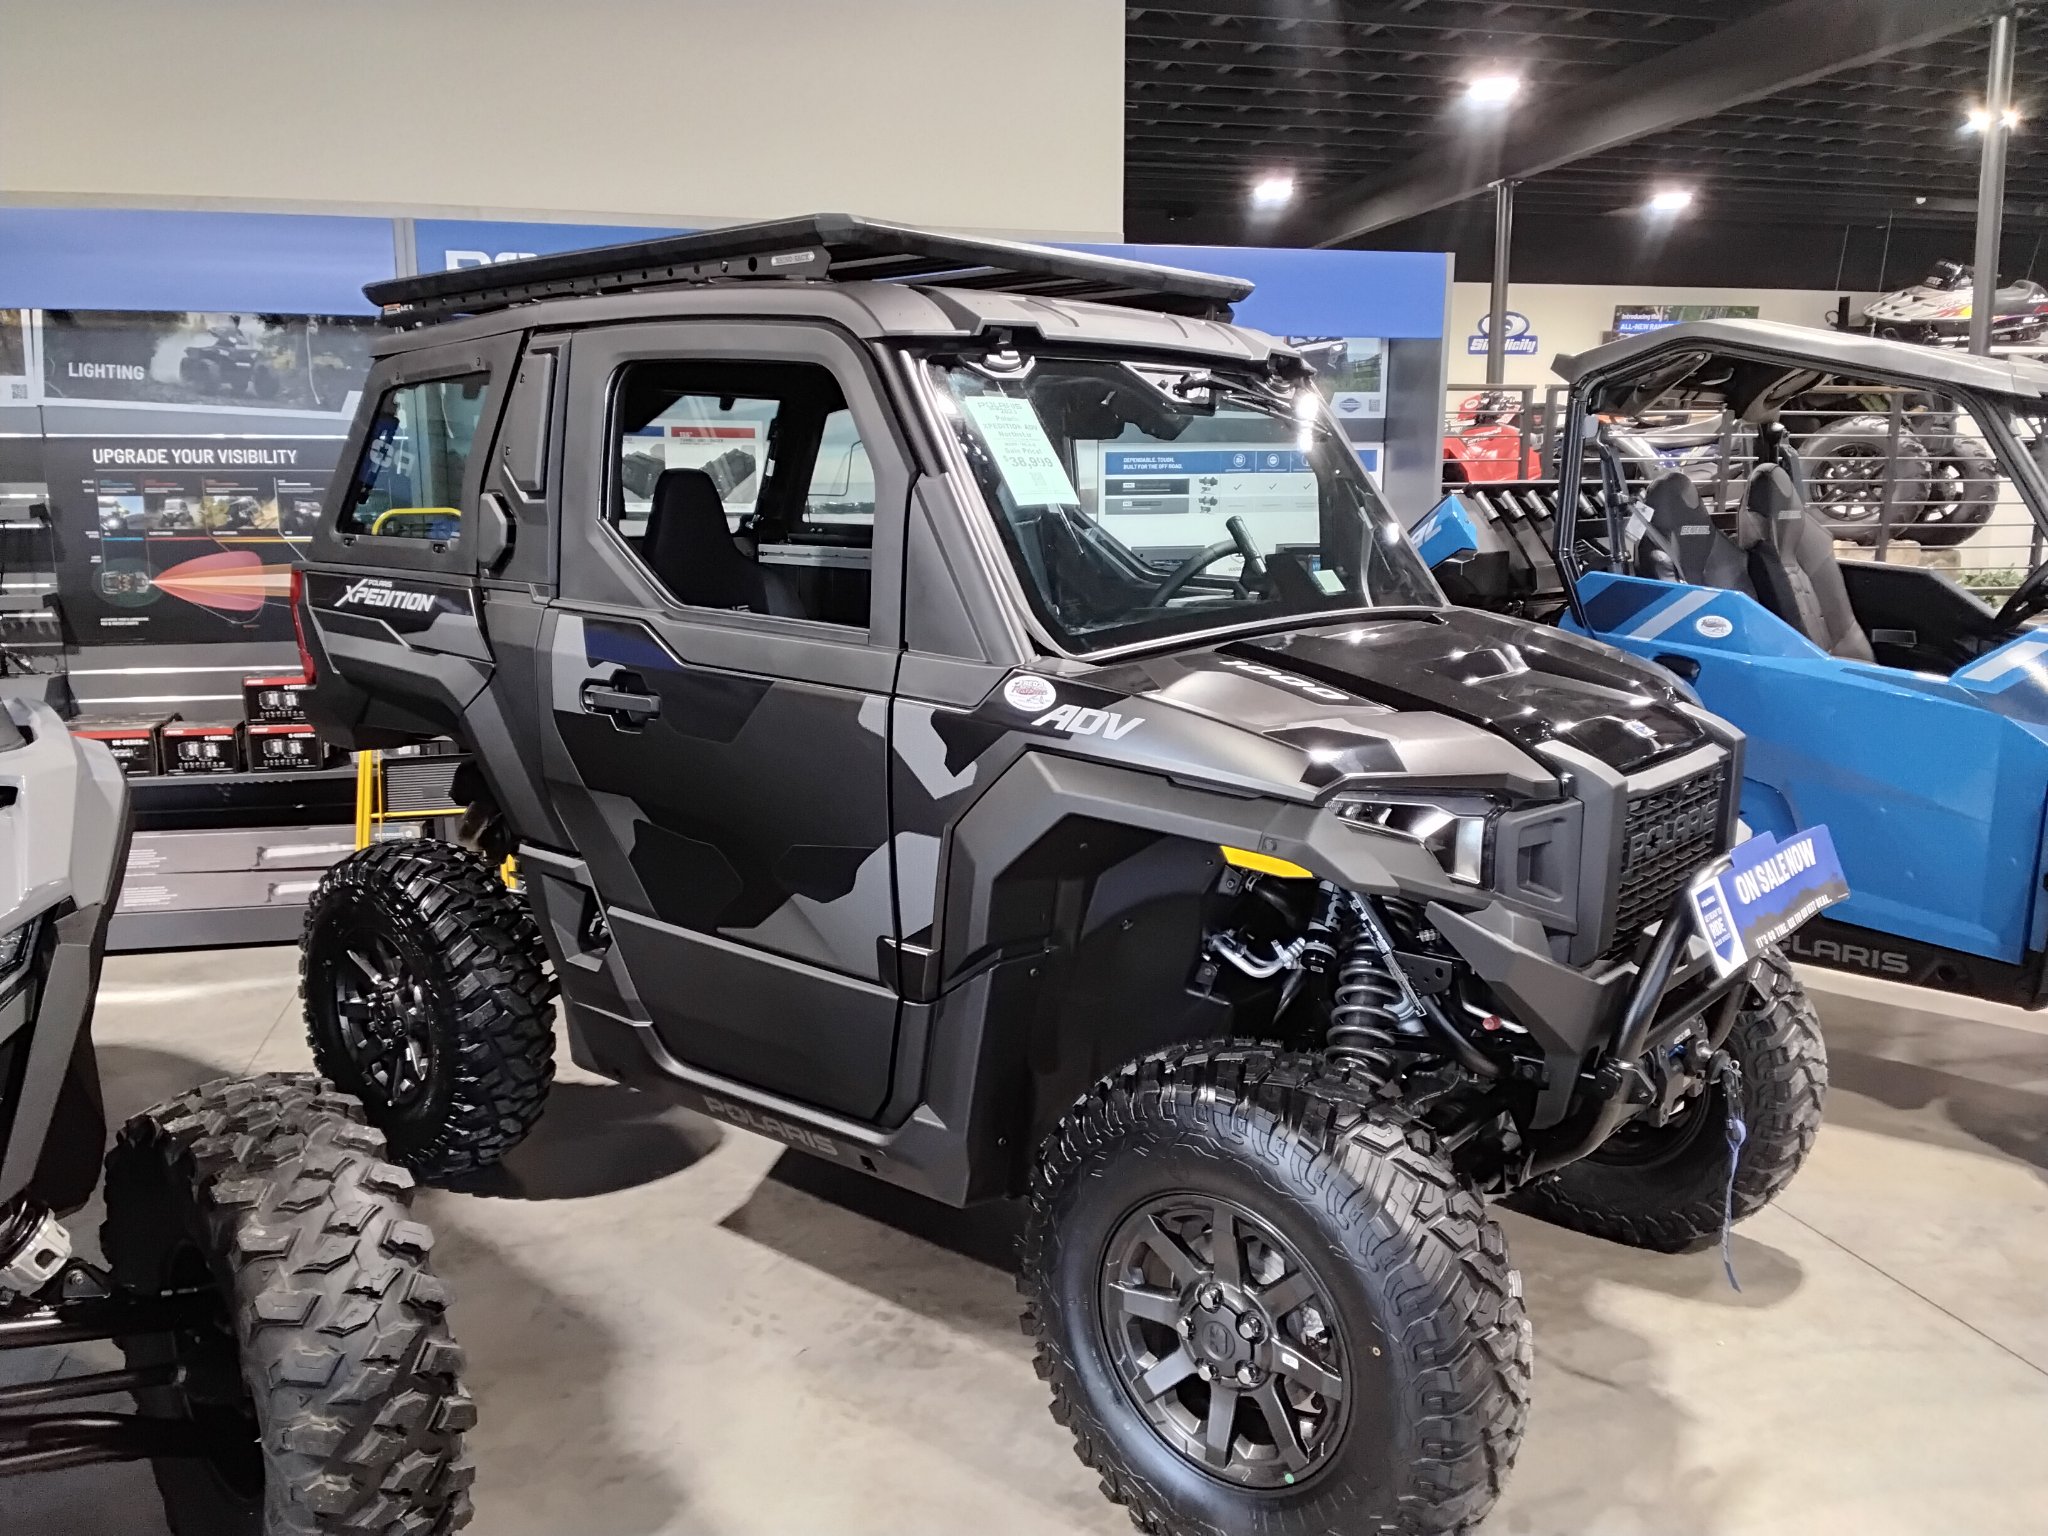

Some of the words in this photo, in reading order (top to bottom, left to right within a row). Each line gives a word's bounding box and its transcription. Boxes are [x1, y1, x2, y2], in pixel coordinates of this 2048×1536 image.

[1470, 338, 1536, 353] Silicity
[68, 362, 145, 380] LIGHTING
[92, 448, 169, 464] UPGRADE
[171, 448, 215, 464] YOUR
[218, 449, 297, 465] VISIBILITY
[334, 579, 435, 612] XPEDITION
[368, 580, 392, 588] POLARIS
[1219, 661, 1349, 700] 1000
[1031, 703, 1146, 740] ADV
[1628, 798, 1720, 866] POLARIS
[1736, 869, 1762, 905] ON
[1755, 852, 1792, 893] SALE
[1783, 838, 1817, 877] NOW
[1780, 935, 1910, 974] LARIS
[702, 1095, 838, 1156] POLARIS
